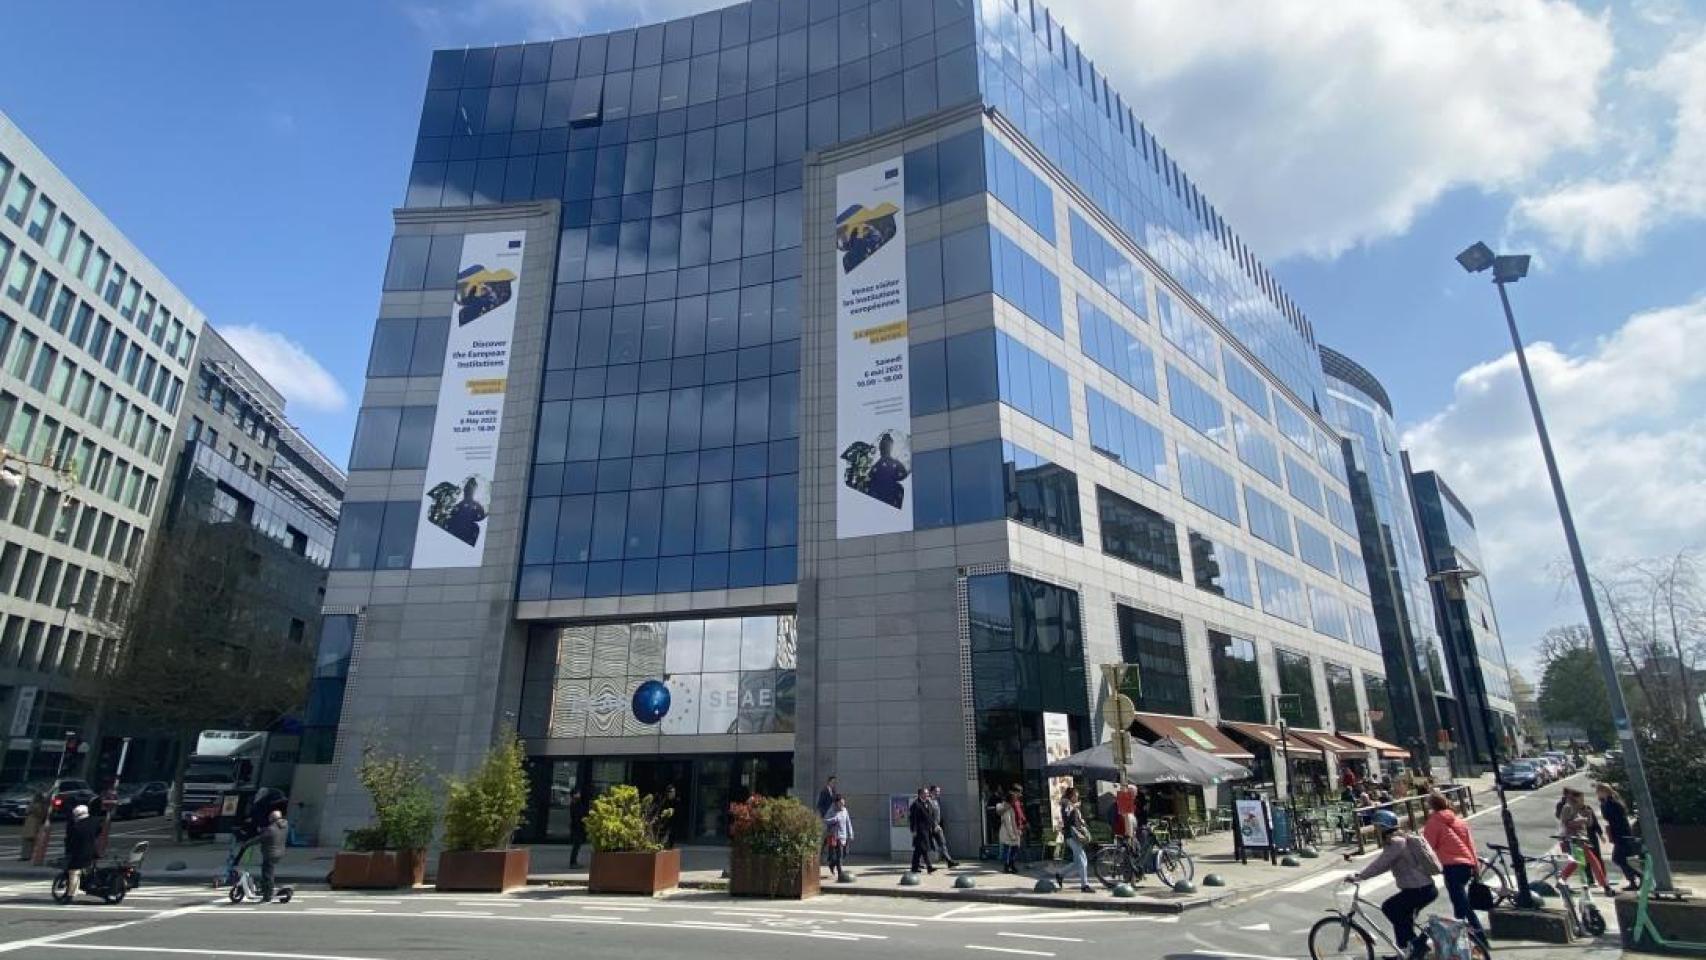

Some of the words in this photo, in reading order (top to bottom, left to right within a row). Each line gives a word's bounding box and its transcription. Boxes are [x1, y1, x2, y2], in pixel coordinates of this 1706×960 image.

[855, 289, 900, 304] institutions
[467, 350, 507, 358] European
[710, 688, 773, 707] SEAE
